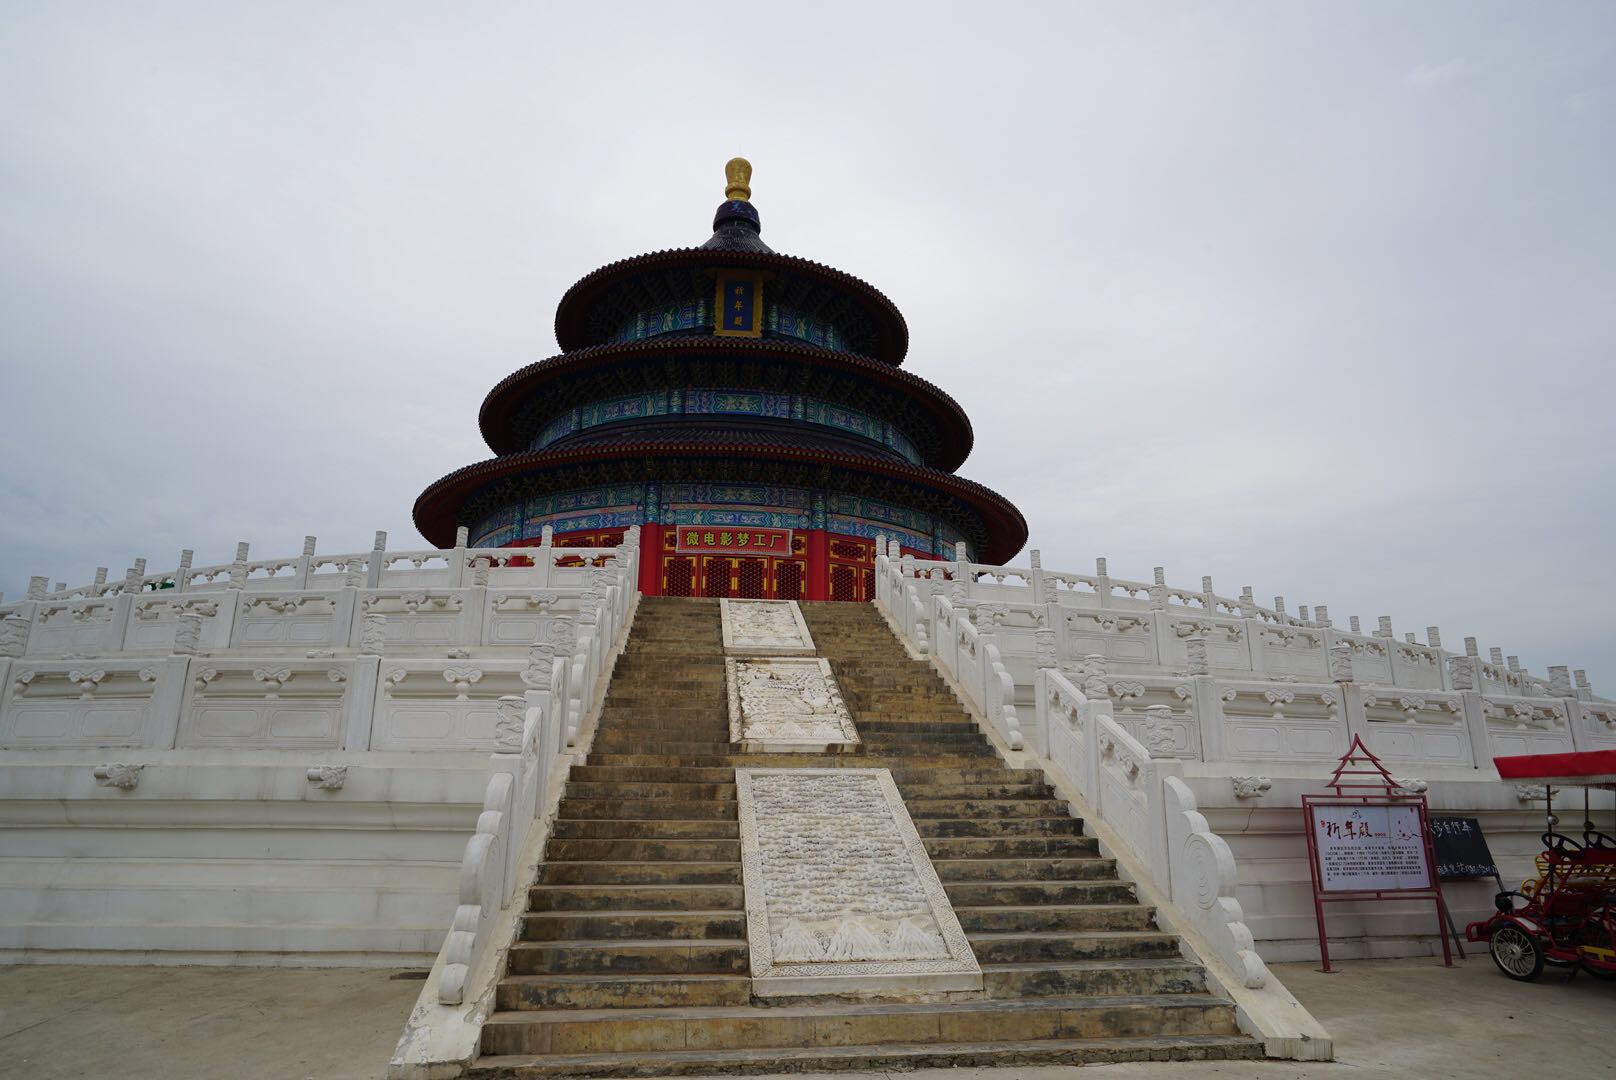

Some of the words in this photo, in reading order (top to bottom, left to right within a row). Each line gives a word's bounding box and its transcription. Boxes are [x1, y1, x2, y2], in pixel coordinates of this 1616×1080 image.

[686, 531, 783, 547] 微电影梦工厂
